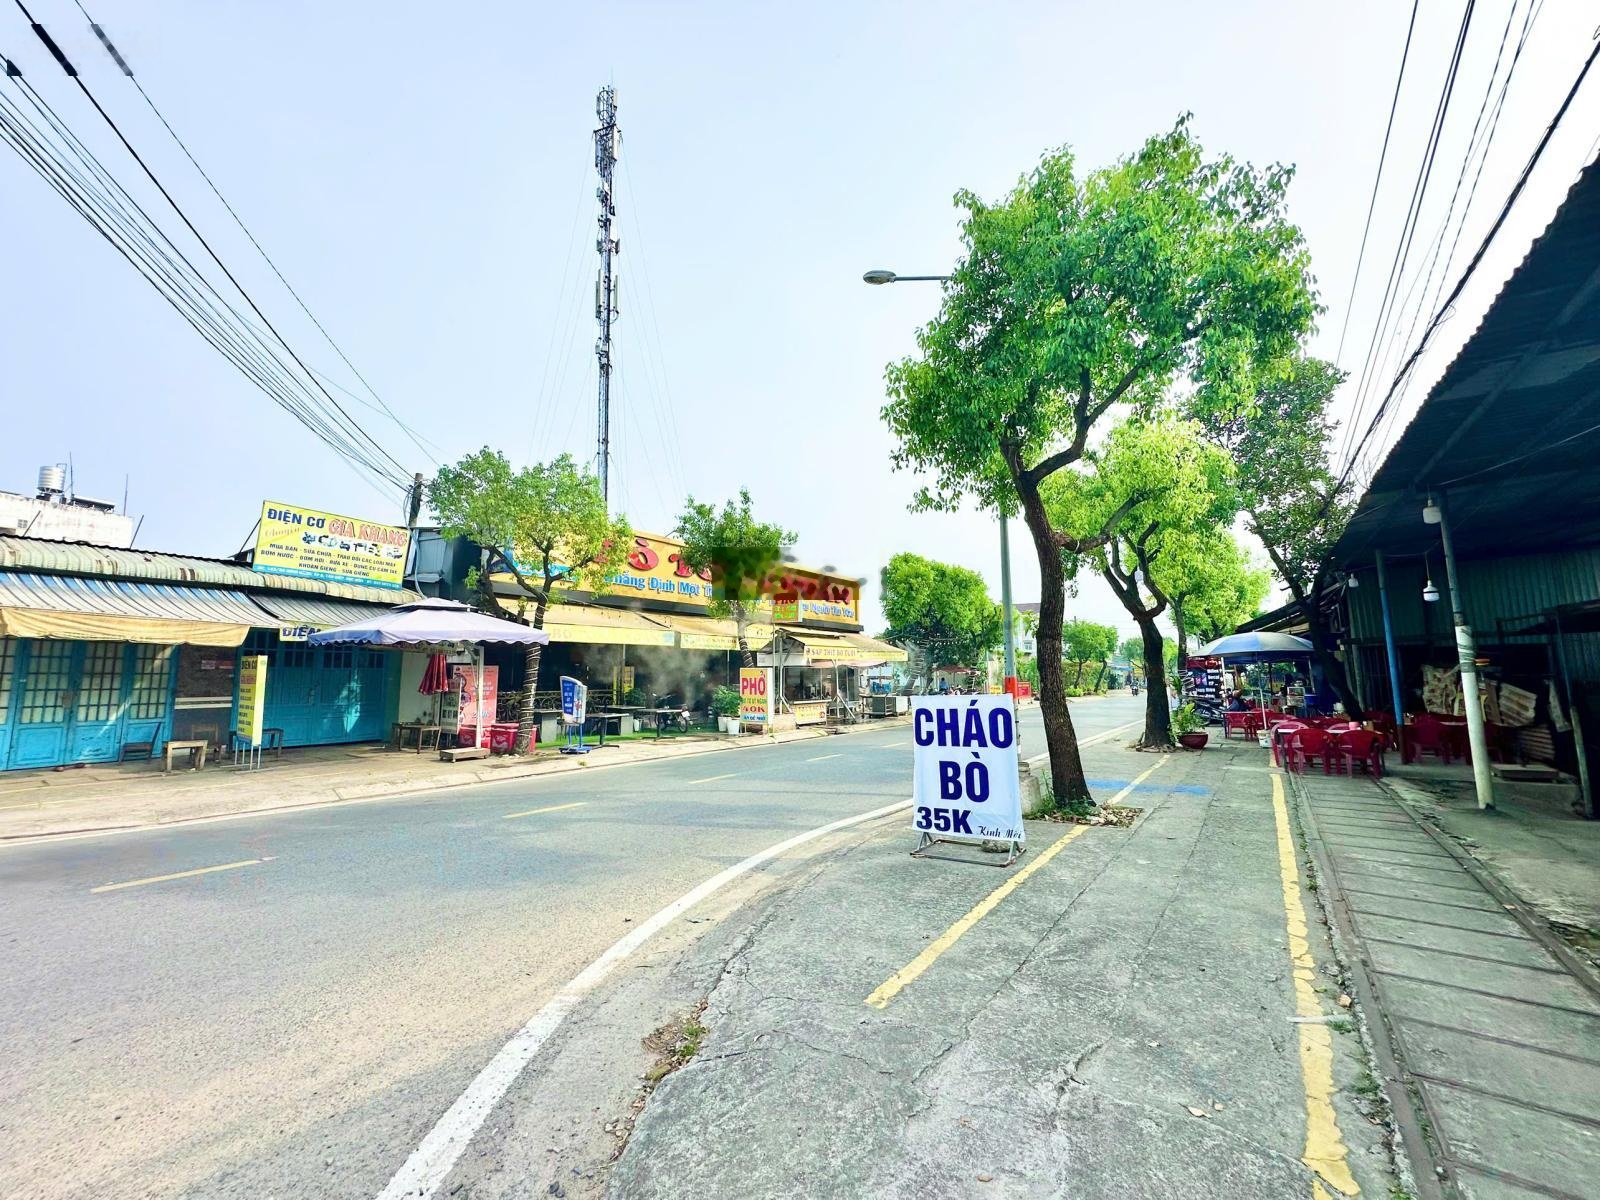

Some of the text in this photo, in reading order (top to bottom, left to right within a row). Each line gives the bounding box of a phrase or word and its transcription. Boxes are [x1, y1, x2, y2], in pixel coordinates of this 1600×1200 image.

[267, 508, 408, 547] ĐIỆN CƠ GIA KHANG
[649, 576, 675, 594] Định
[678, 581, 700, 598] Một
[741, 670, 766, 696] PHỞ
[914, 699, 1014, 749] CHÁO
[939, 751, 990, 803] BÒ
[916, 806, 973, 834] 35K
